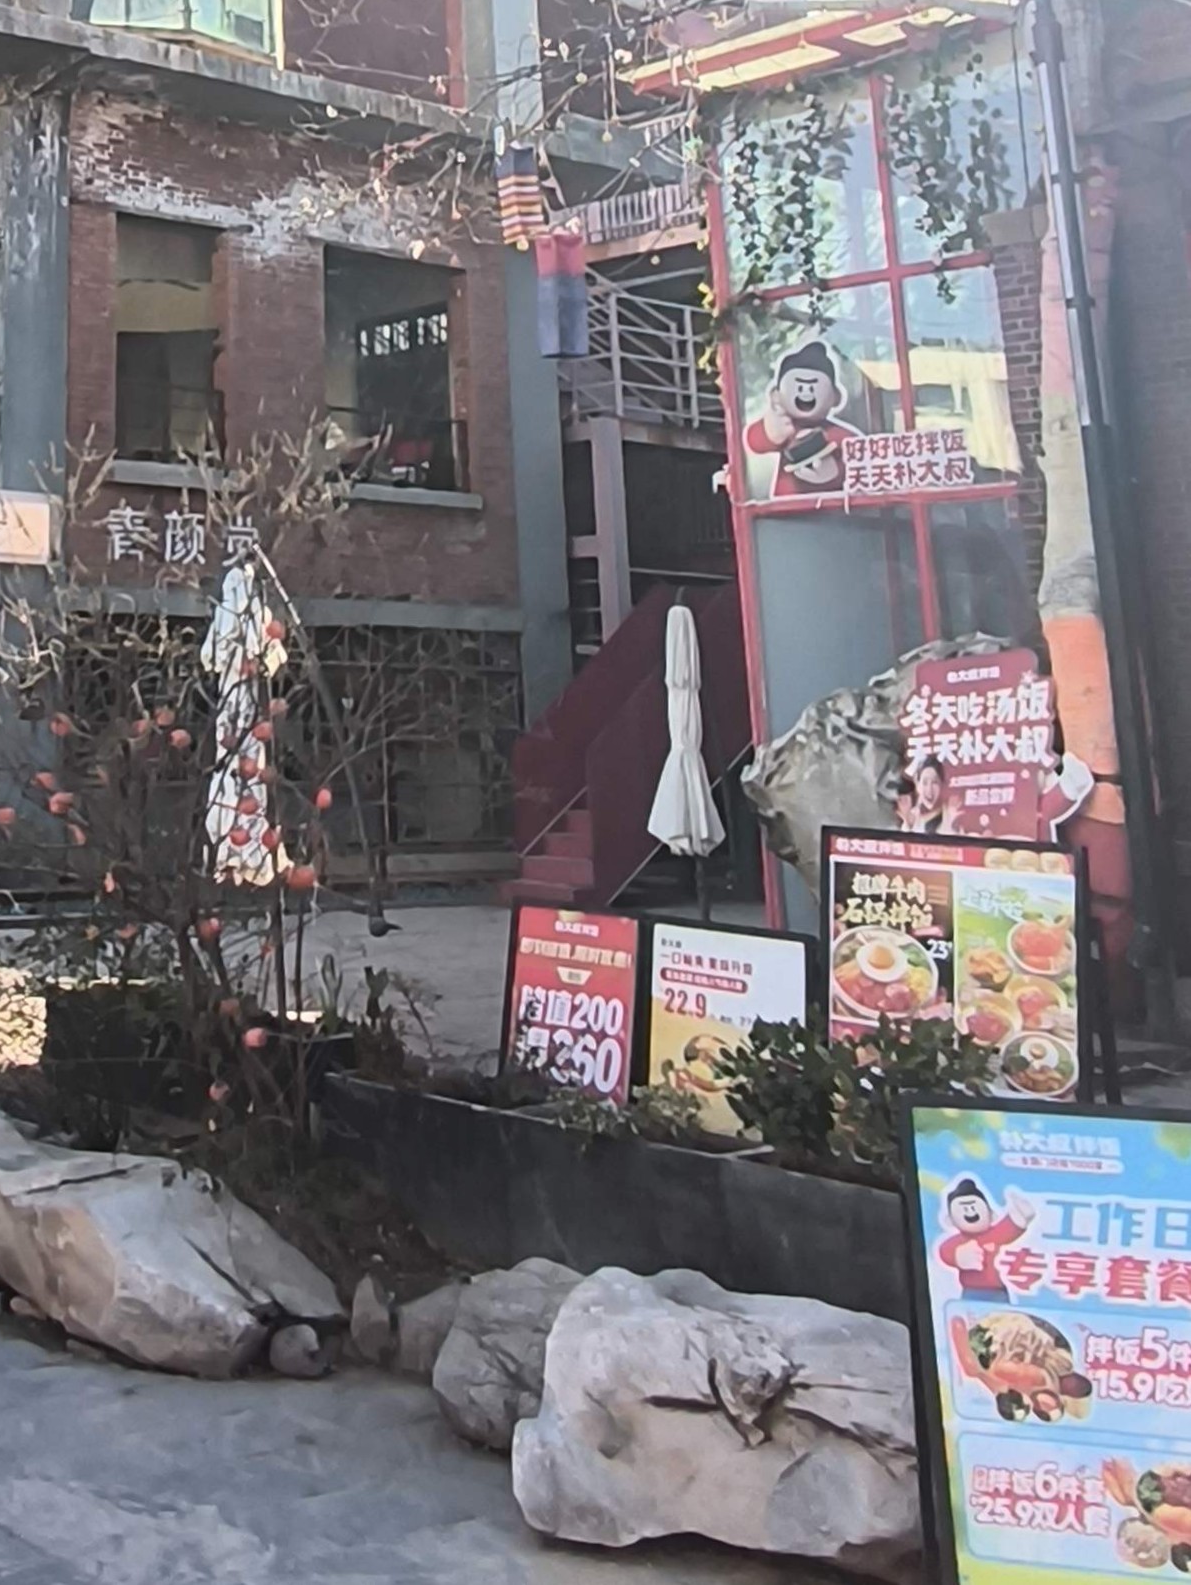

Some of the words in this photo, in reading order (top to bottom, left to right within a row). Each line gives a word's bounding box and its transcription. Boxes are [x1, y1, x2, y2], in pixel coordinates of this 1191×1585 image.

[845, 428, 967, 462] 好好吃拌饭
[848, 456, 970, 488] 天天朴大叔
[899, 679, 1050, 736] 冬天吃汤饭
[904, 724, 1055, 776] 天天朴大叔
[1041, 1199, 1191, 1250] 工作日
[999, 1247, 1191, 1304] 专享套餐
